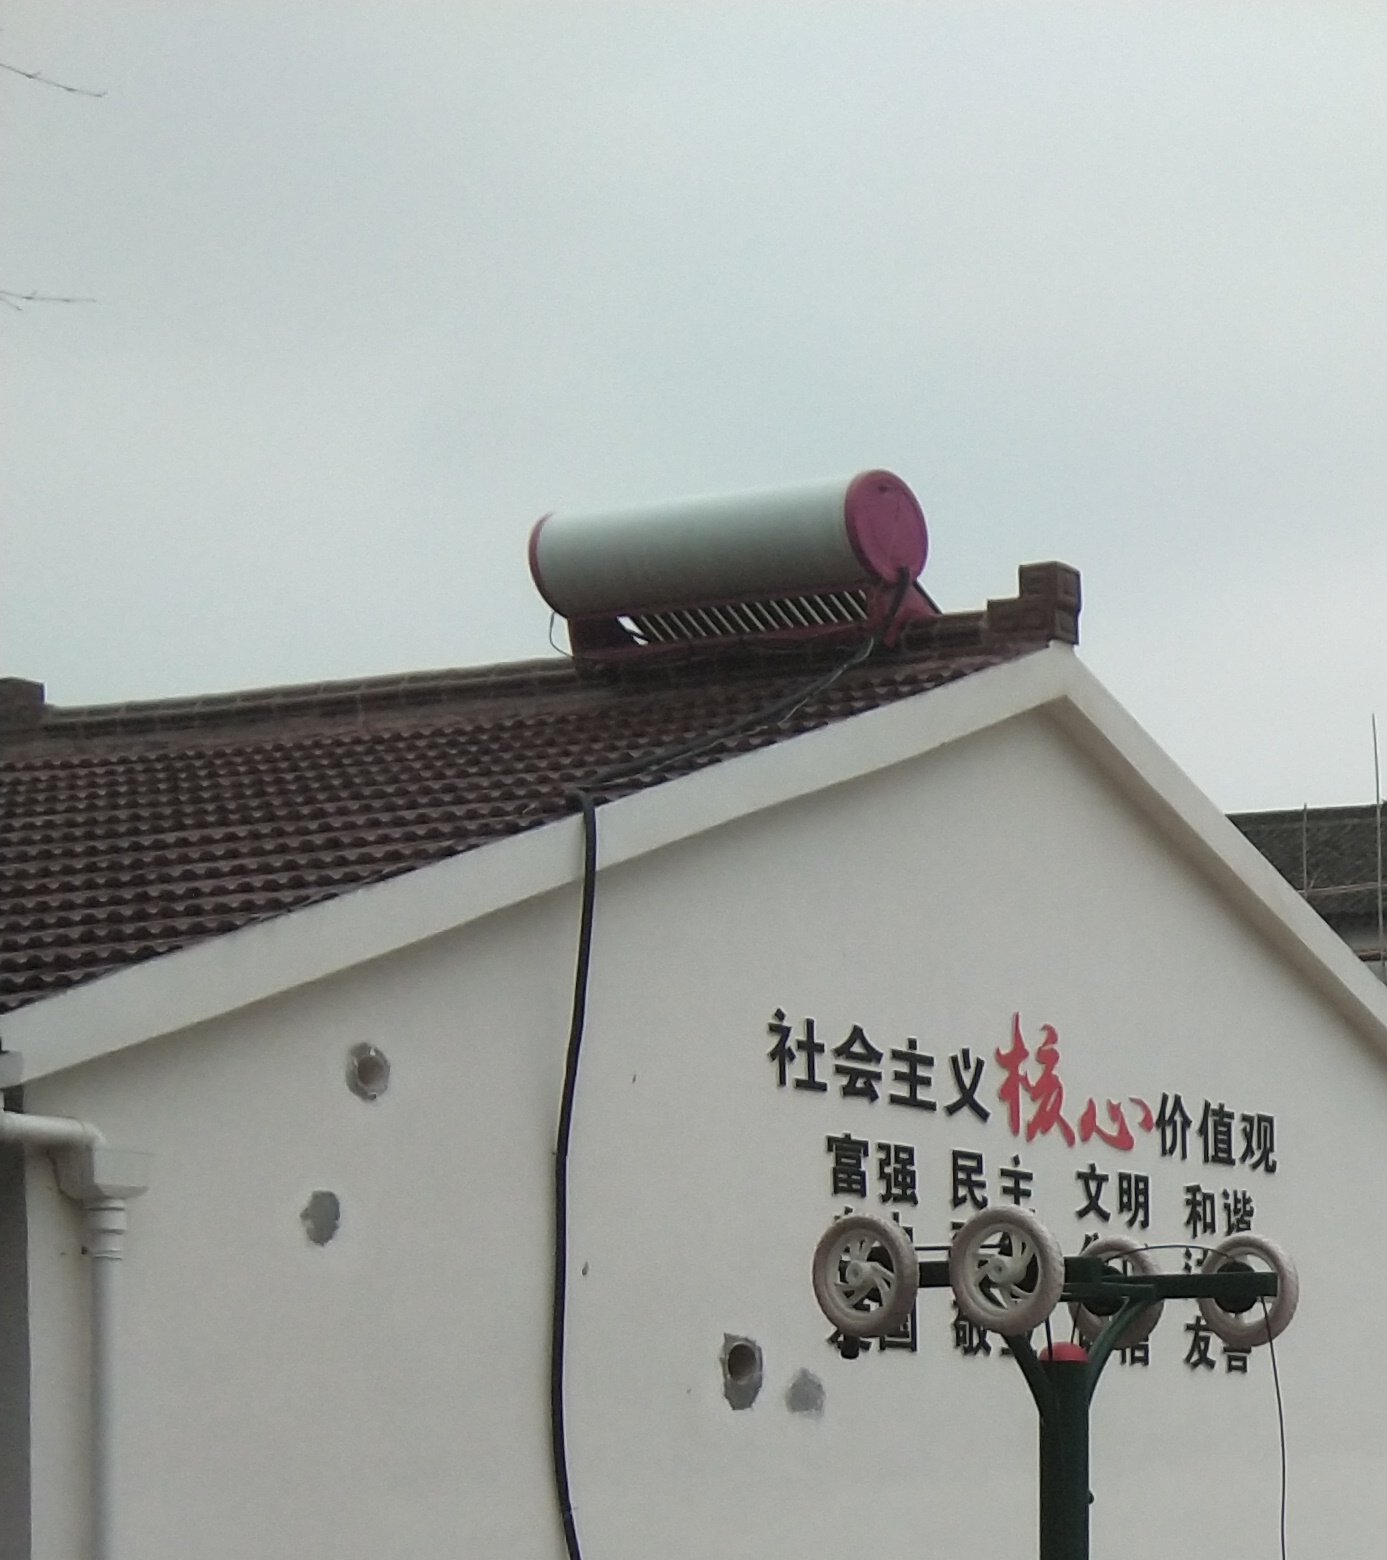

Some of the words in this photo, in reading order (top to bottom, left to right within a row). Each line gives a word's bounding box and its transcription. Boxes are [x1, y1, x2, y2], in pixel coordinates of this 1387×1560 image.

[767, 1007, 1277, 1174] 社会主义核心价值观
[826, 1133, 918, 1206] 富强
[952, 1149, 1034, 1210] 民主
[1075, 1162, 1149, 1229] 文明
[1184, 1184, 1254, 1238] 和谐
